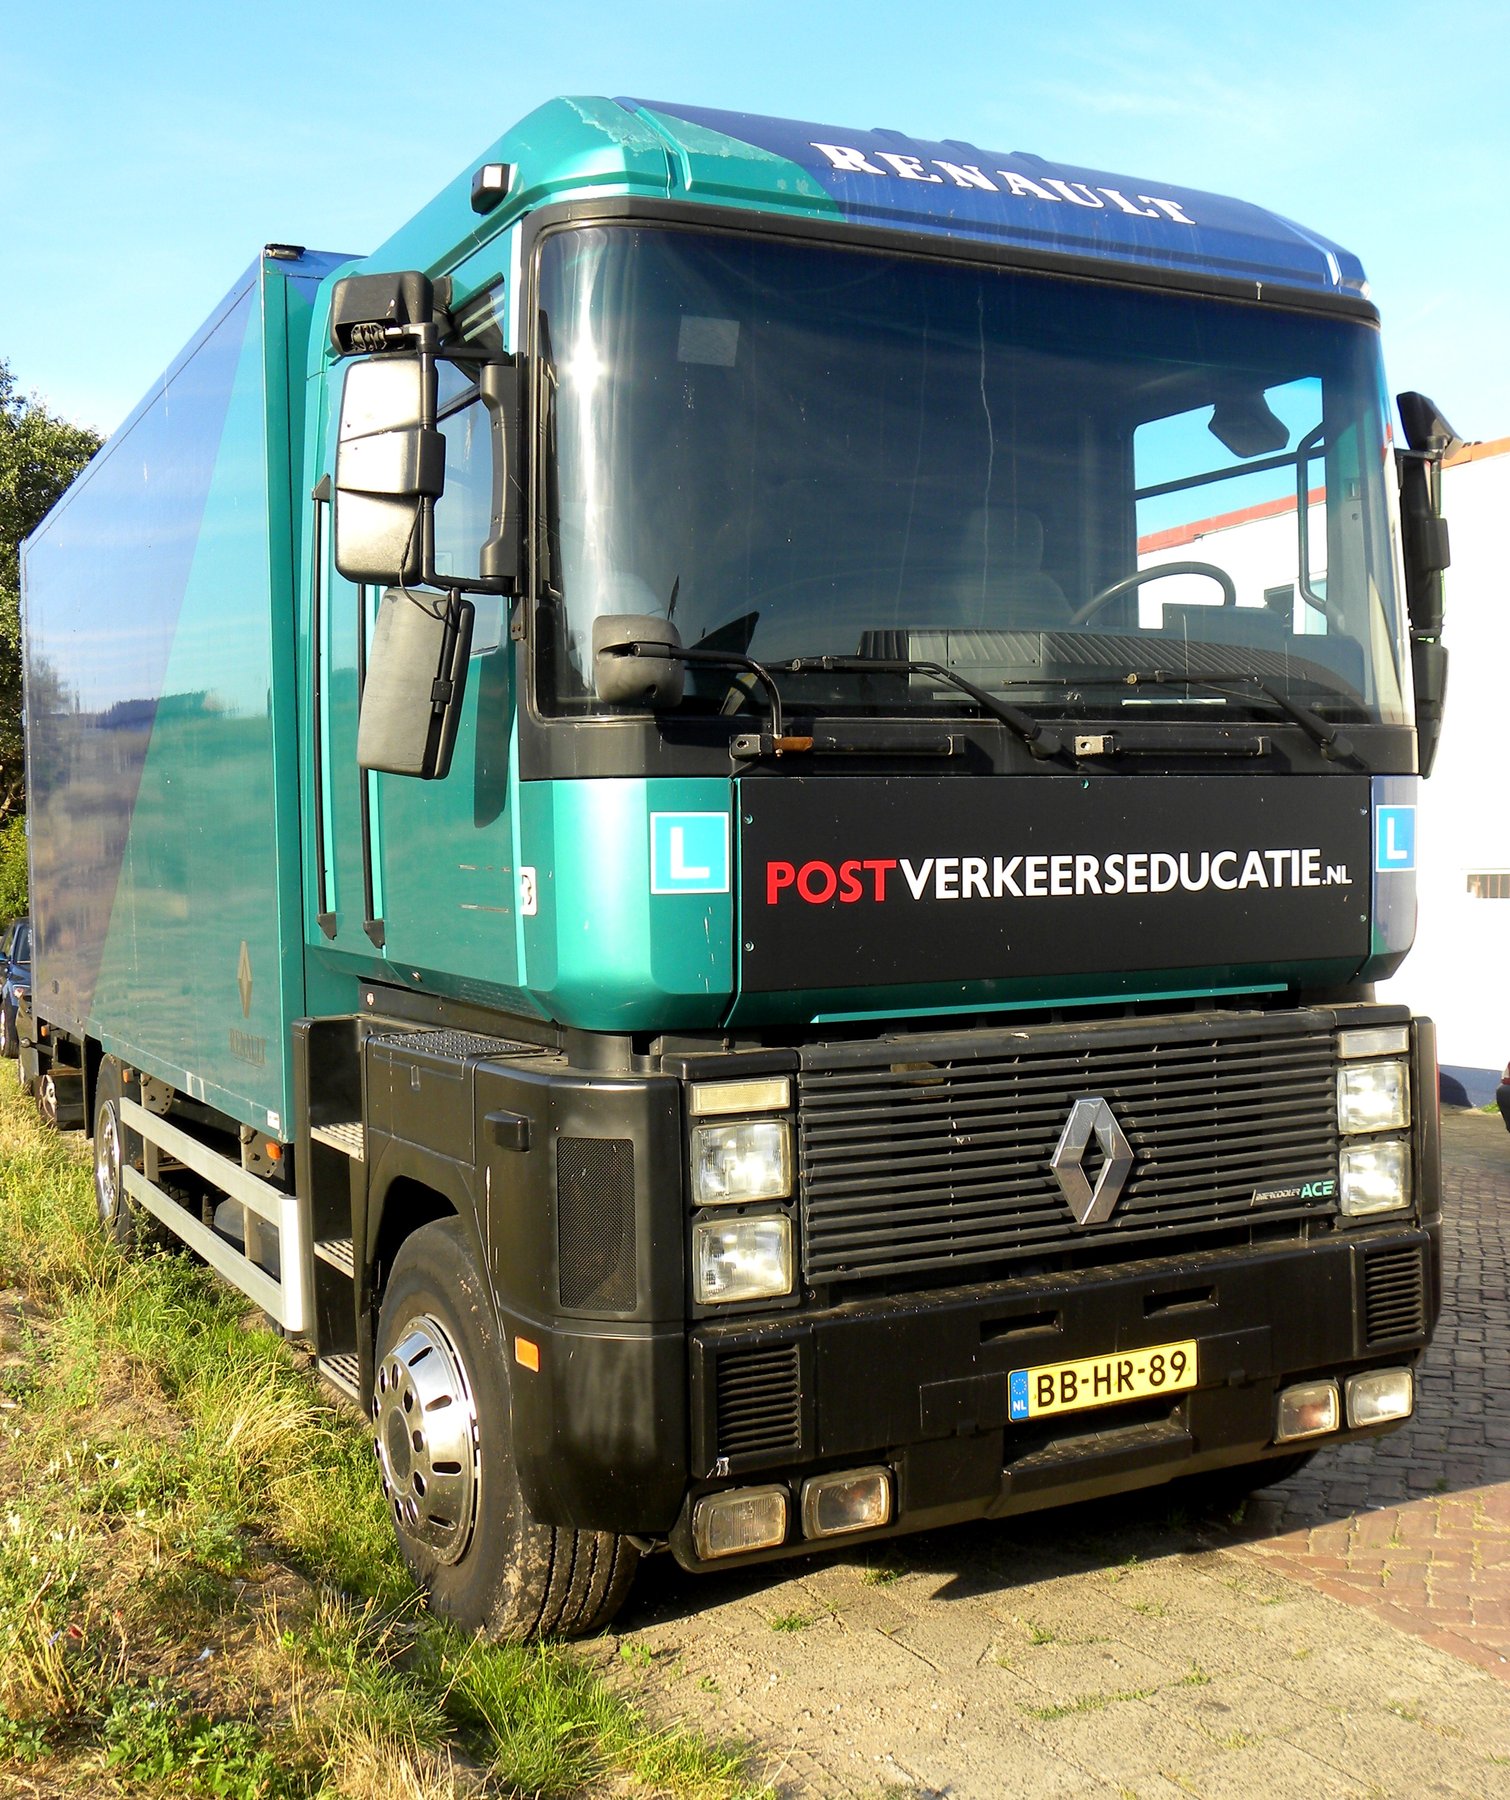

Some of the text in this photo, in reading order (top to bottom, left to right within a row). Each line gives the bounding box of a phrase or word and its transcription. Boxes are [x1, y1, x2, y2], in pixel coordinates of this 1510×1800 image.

[809, 142, 1197, 225] RENAULT
[670, 827, 710, 879] L
[1386, 816, 1407, 860] L
[766, 848, 1353, 905] POSTVERKEERSEDUCATIE.NL
[1300, 1180, 1335, 1199] ACE
[1036, 1350, 1187, 1408] BB-HR-89
[1013, 1400, 1027, 1411] NL
